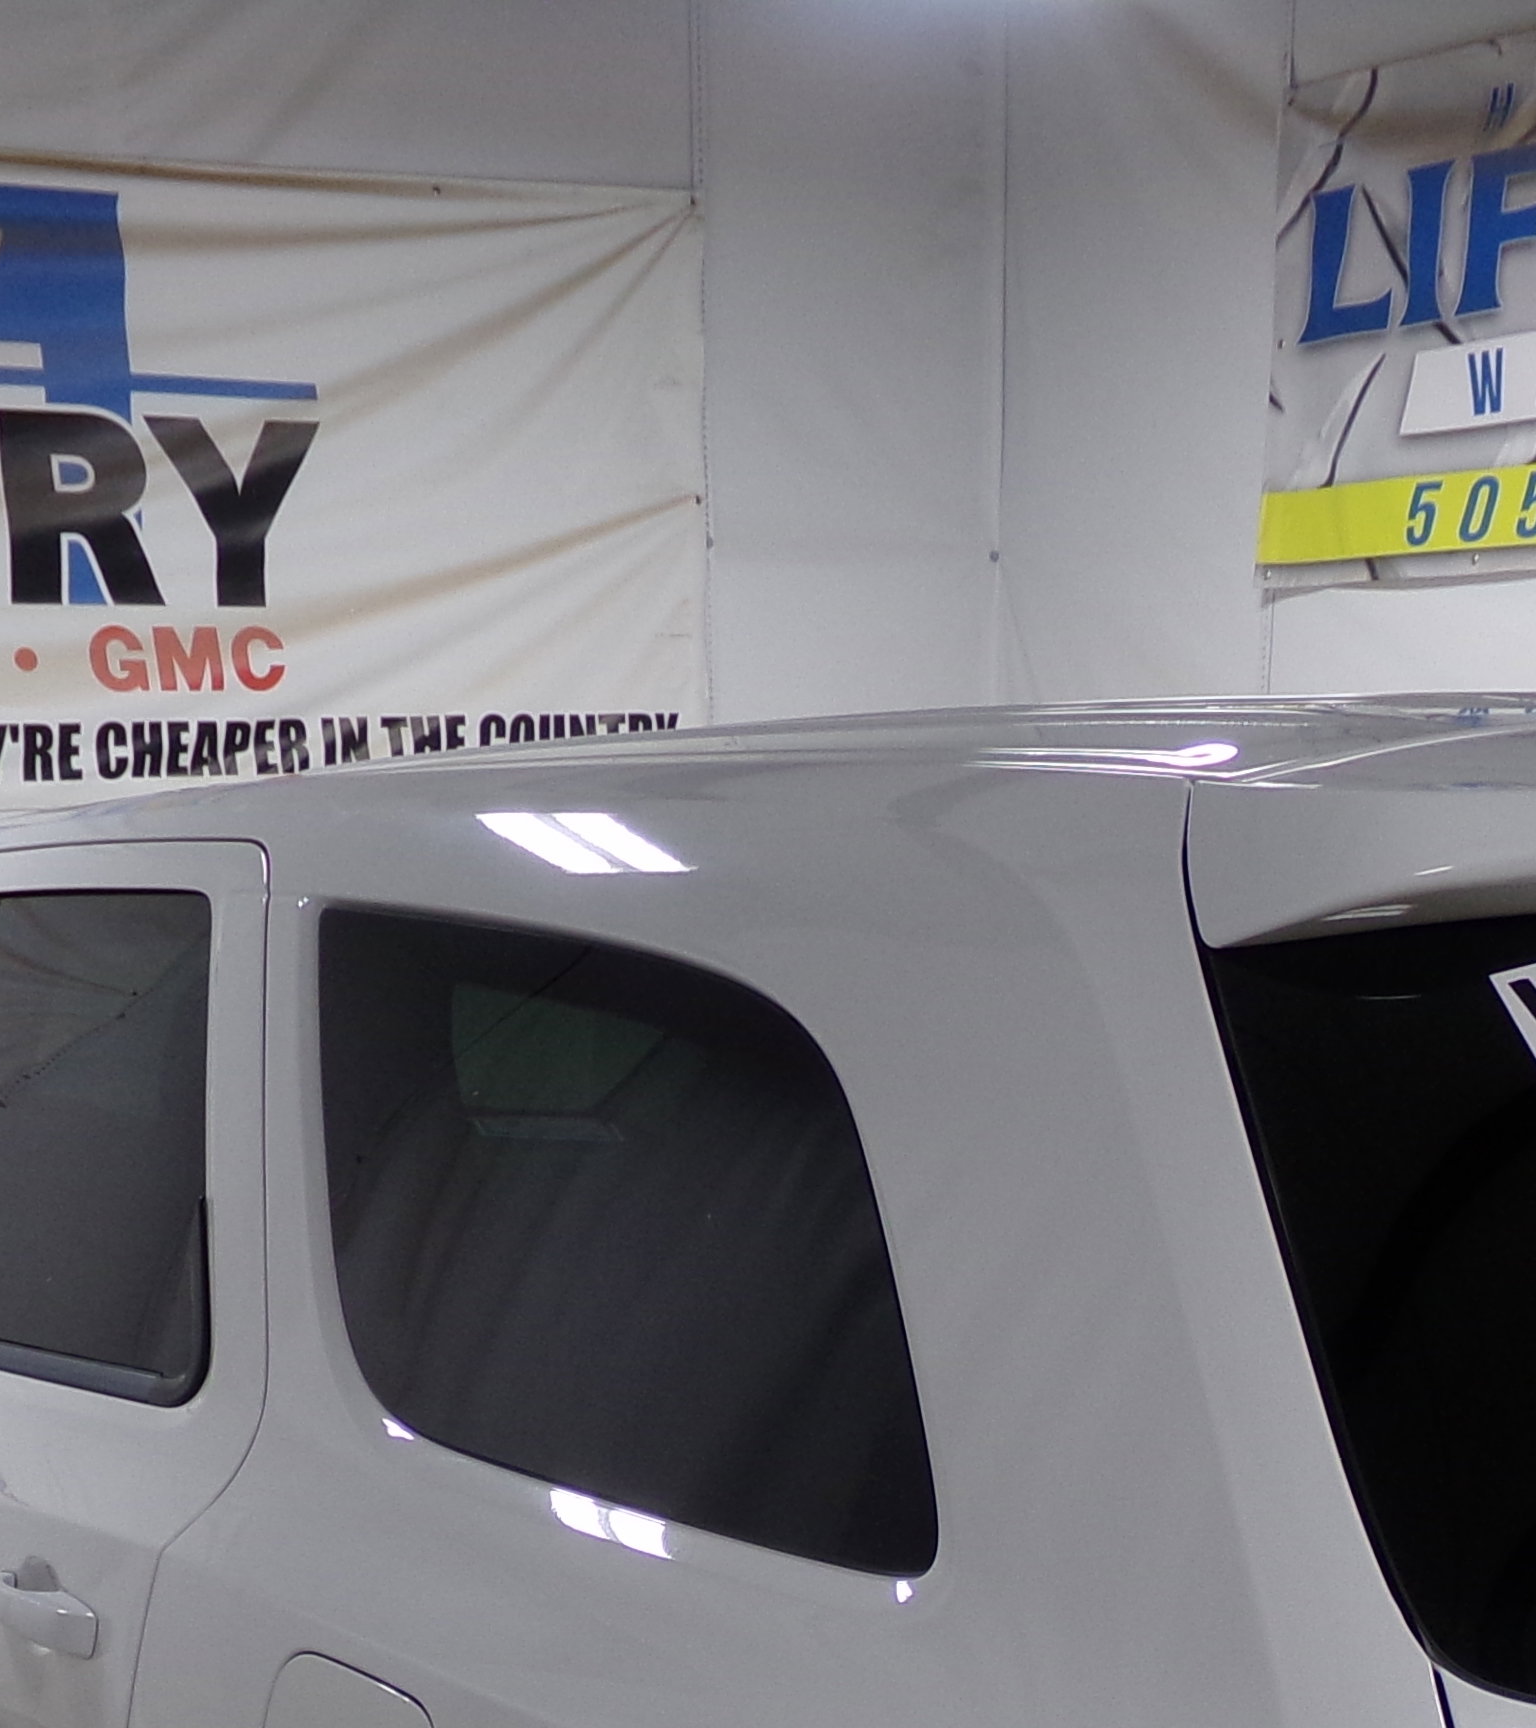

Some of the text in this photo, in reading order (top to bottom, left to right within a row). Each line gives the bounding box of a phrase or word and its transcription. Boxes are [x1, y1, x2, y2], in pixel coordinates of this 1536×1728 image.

[88, 624, 287, 693] GMC
[95, 717, 312, 778] CHEAPER
[323, 716, 372, 766] IN
[380, 715, 468, 758] THE
